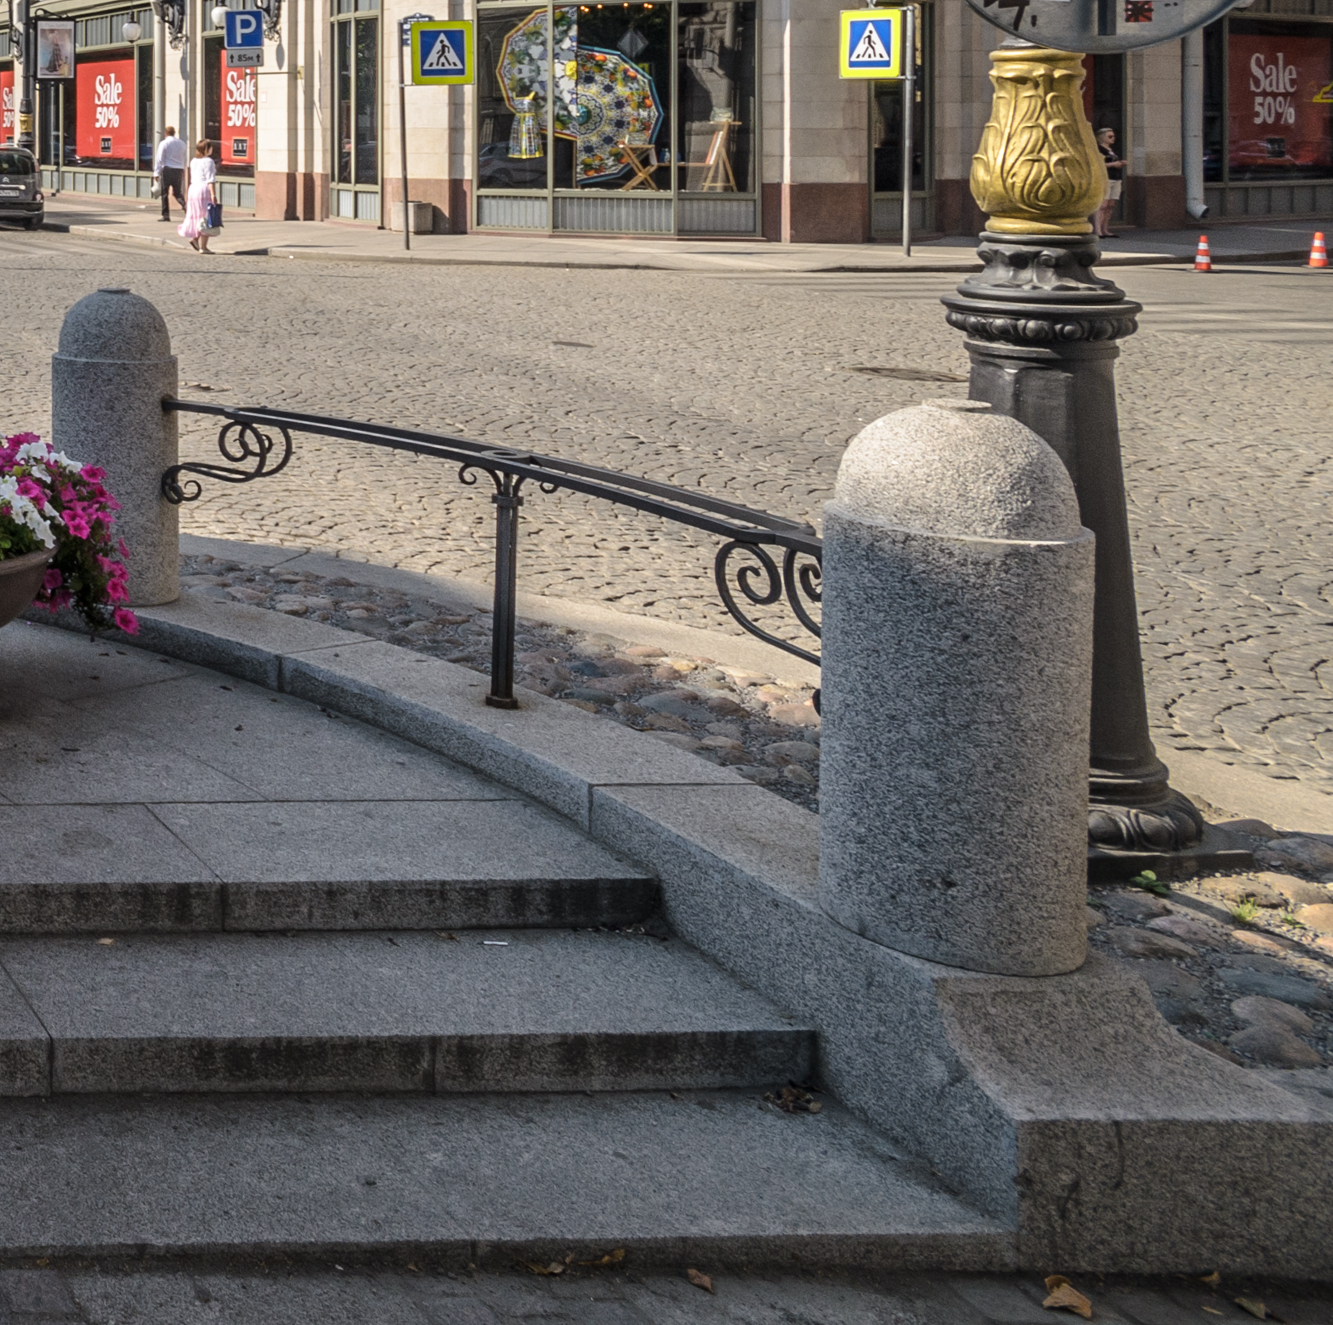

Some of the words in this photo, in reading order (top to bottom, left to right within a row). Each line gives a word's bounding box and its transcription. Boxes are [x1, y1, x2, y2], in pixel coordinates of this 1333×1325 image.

[1250, 52, 1297, 93] Sale
[94, 73, 122, 105] Sale
[95, 106, 120, 128] 50%
[1253, 96, 1295, 125] 50%
